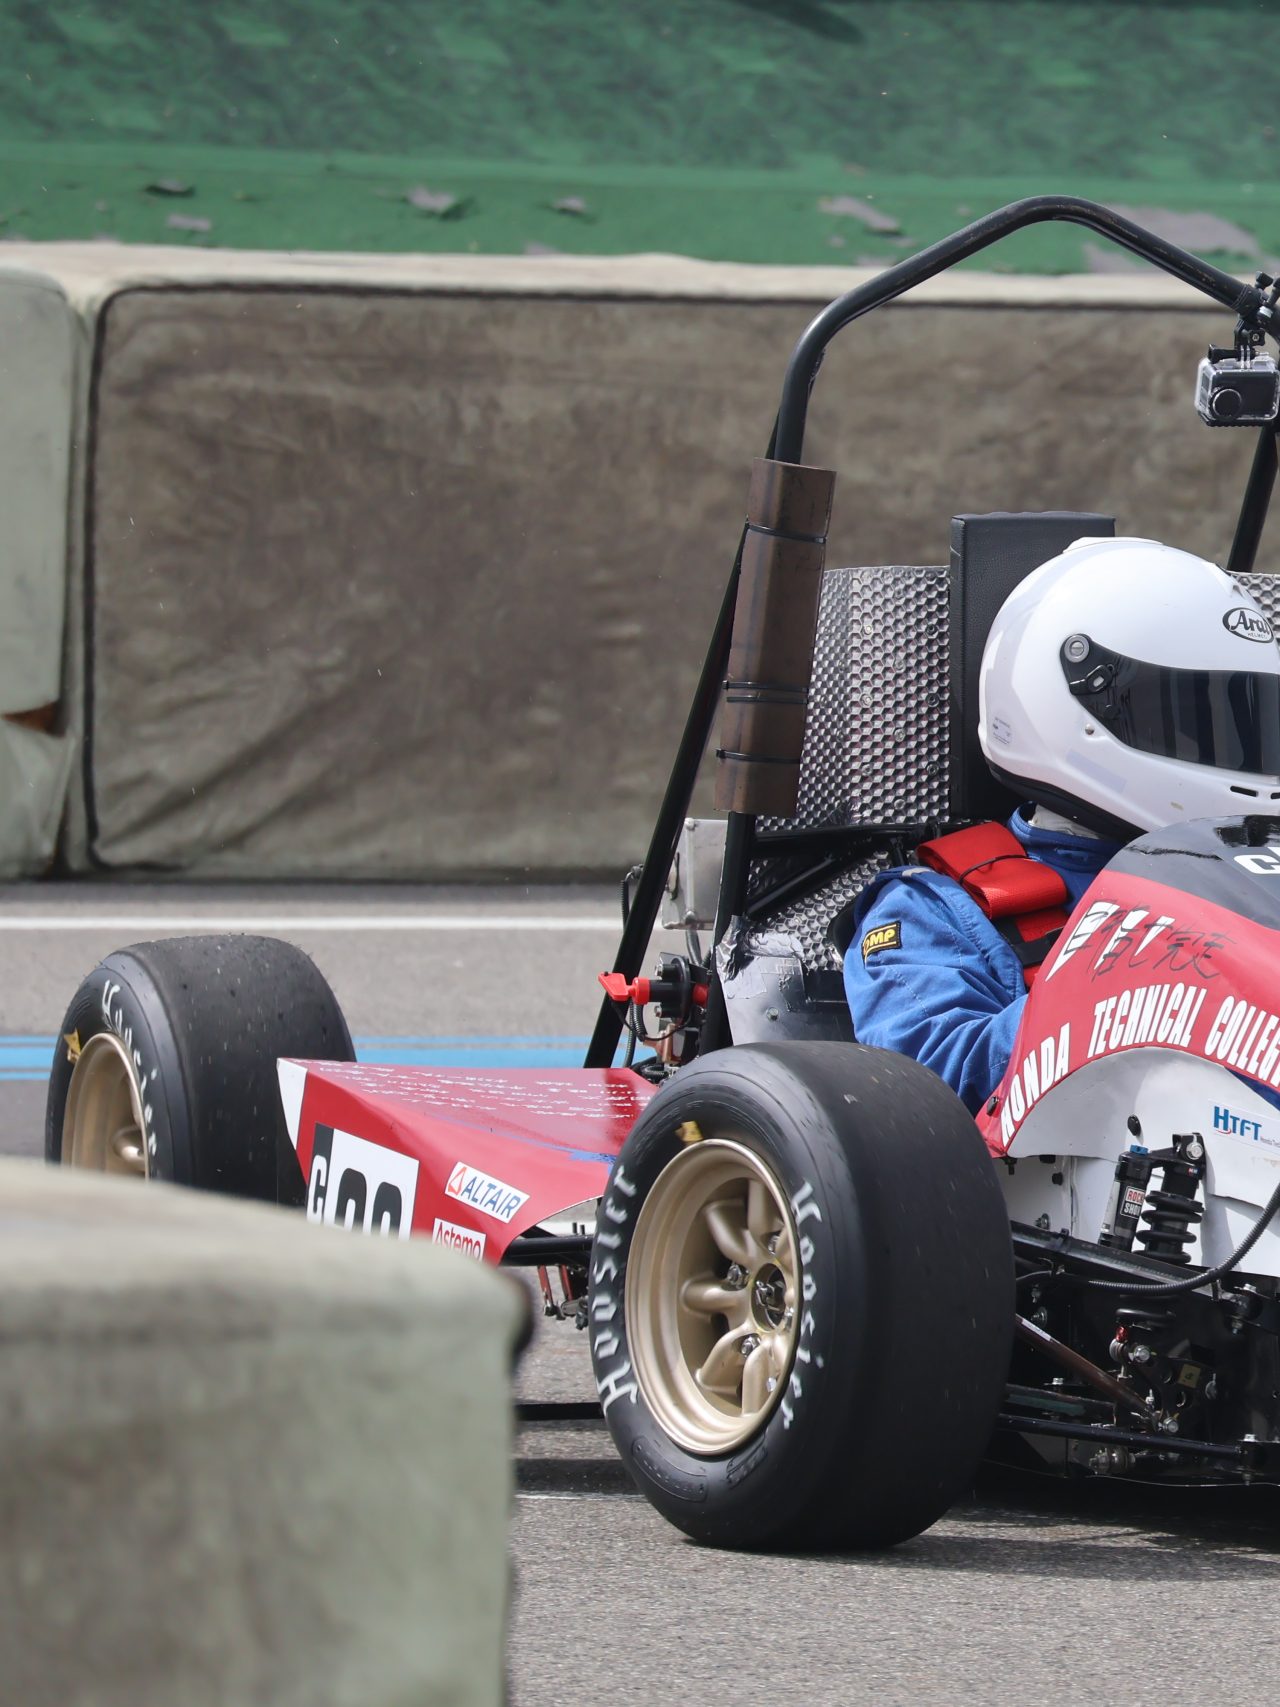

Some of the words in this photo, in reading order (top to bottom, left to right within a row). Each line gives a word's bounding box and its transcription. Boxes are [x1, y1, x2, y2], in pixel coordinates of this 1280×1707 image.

[863, 928, 896, 954] OMP
[1000, 1022, 1071, 1147] HONDA
[1087, 982, 1208, 1059] TECHNICAL
[1213, 1105, 1263, 1141] HTFT
[460, 1176, 522, 1219] ALTAIR
